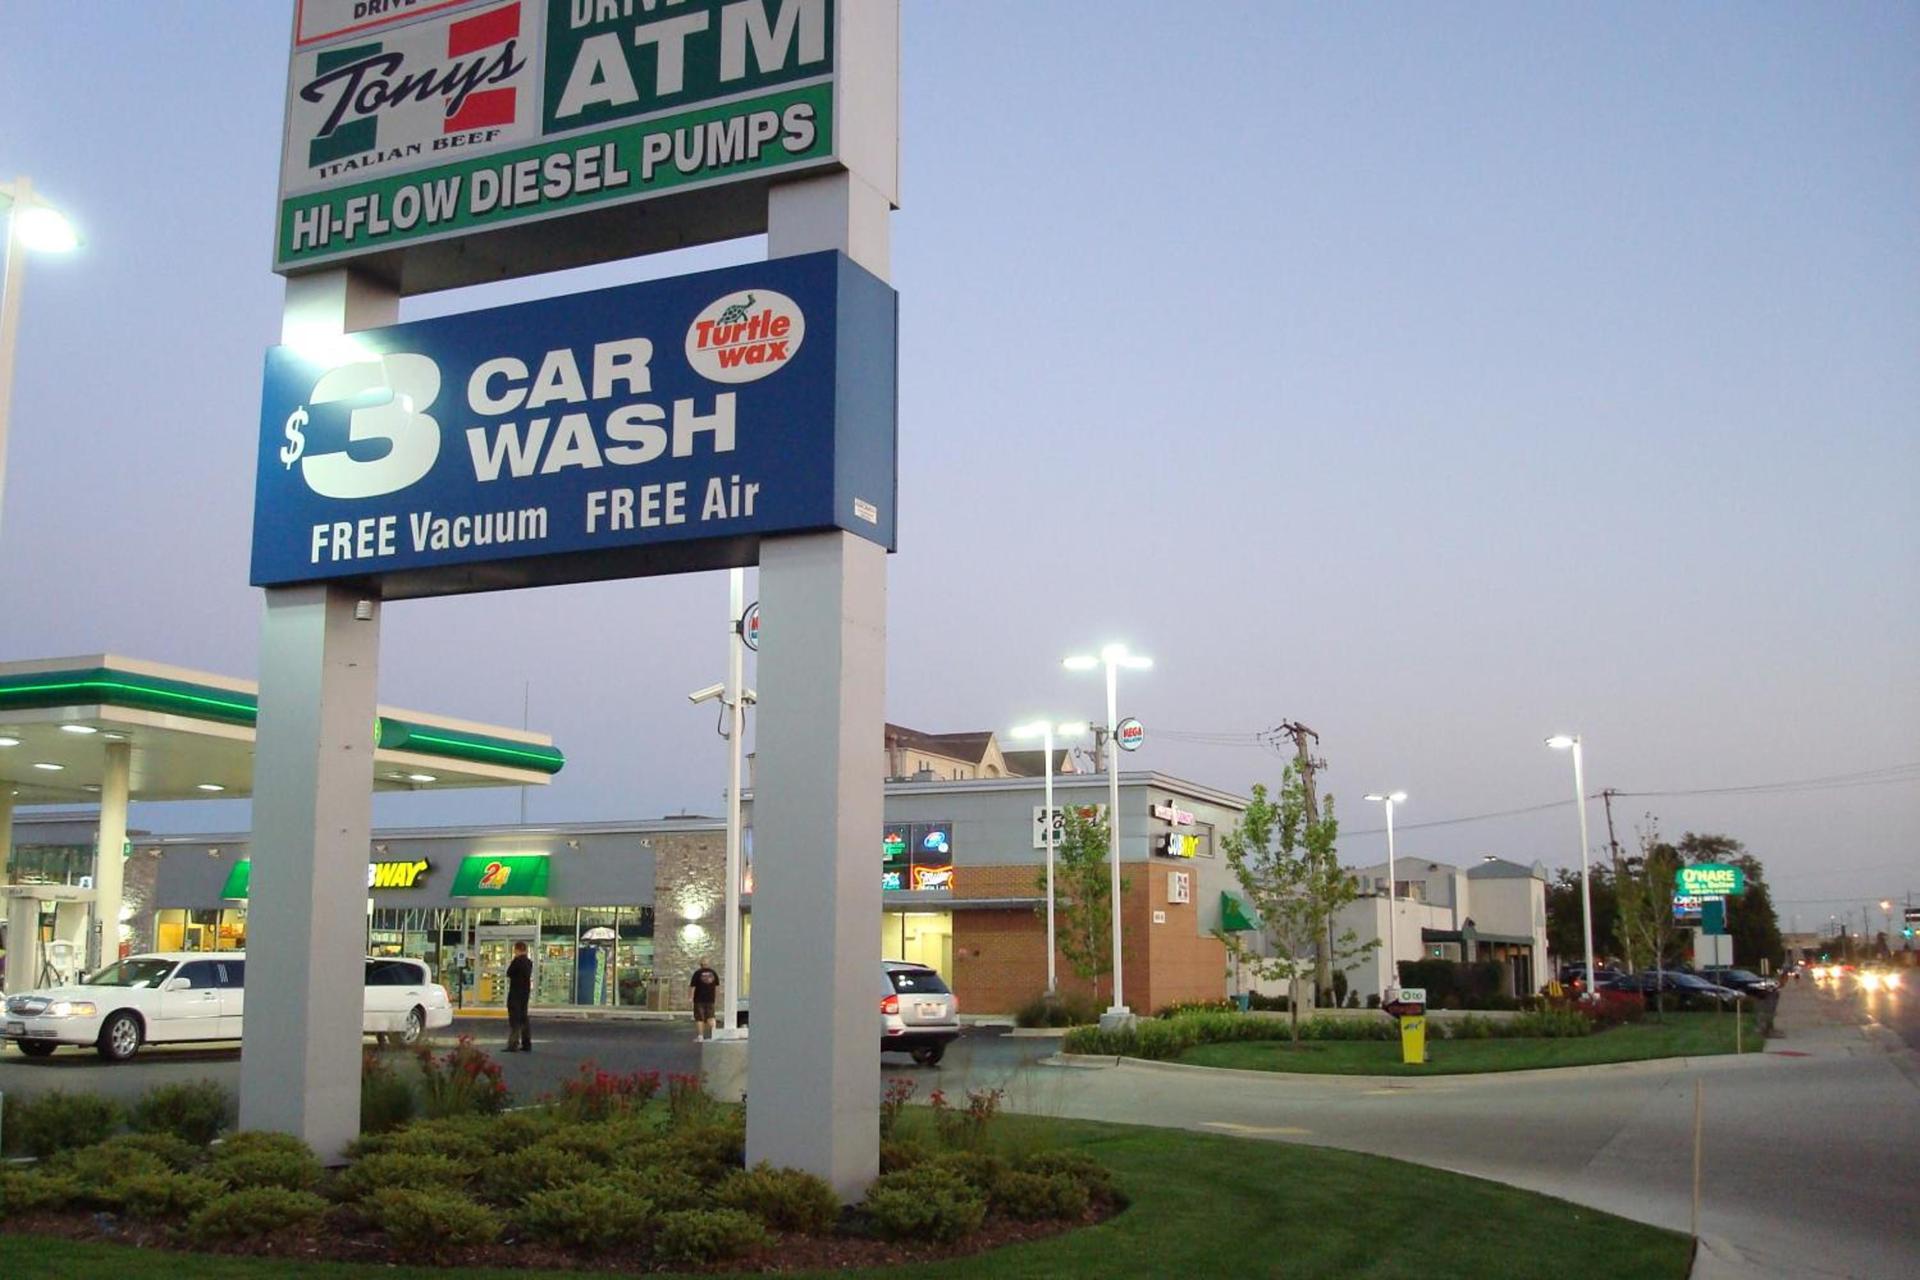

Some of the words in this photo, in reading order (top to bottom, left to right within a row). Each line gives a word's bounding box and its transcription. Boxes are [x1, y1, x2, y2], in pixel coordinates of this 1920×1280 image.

[300, 40, 527, 137] Tonys
[555, 0, 826, 119] ATM
[292, 175, 462, 251] HI-FLOW
[470, 143, 628, 213] DIESEL
[641, 103, 816, 180] PUMPS
[319, 143, 421, 179] ITALIAN
[432, 129, 500, 152] BEEF
[696, 308, 790, 348] Turtle
[718, 341, 787, 368] wax
[467, 337, 653, 416] CAR
[465, 391, 736, 482] WASH
[311, 515, 397, 563] FREE
[410, 505, 547, 552] Vacuum
[586, 481, 687, 534] FREE
[701, 474, 759, 521] Air
